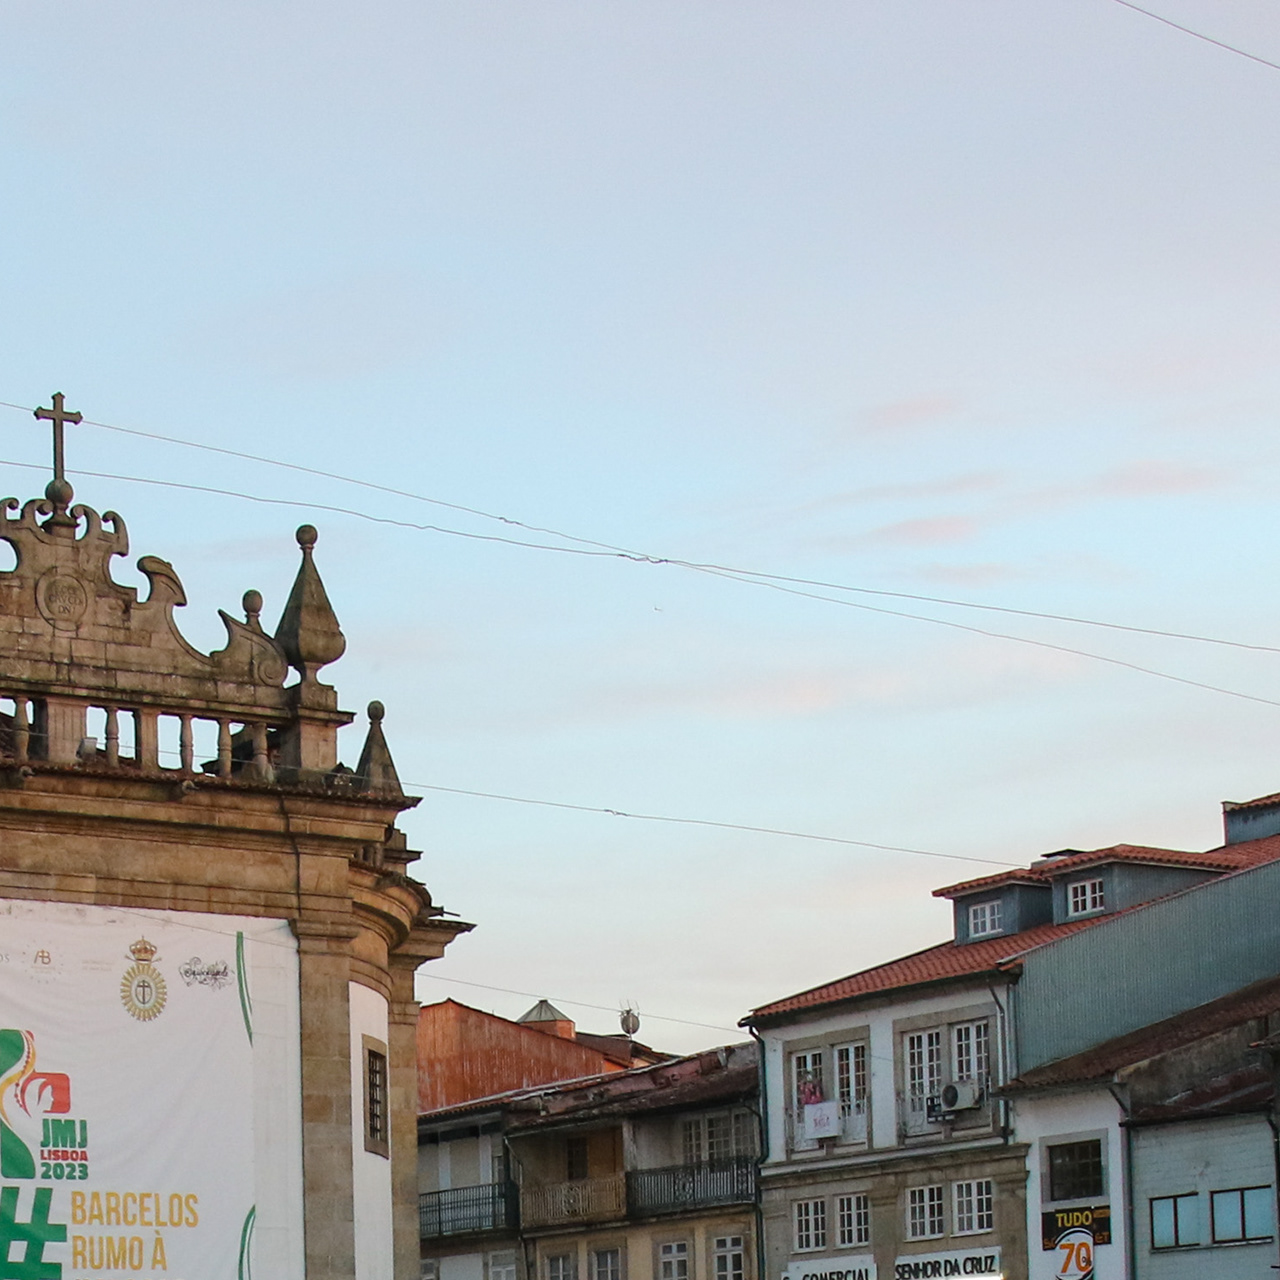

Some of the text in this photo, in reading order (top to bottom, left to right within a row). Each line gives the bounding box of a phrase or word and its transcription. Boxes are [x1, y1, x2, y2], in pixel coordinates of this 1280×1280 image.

[39, 1118, 88, 1148] JMJ
[40, 1149, 89, 1161] LISBOA
[40, 1162, 89, 1180] 2023
[71, 1190, 199, 1228] BARCELOS
[1055, 1210, 1093, 1228] TUDO
[72, 1230, 168, 1270] RUMO À
[943, 1258, 961, 1277] DA
[962, 1254, 997, 1274] CRUZ
